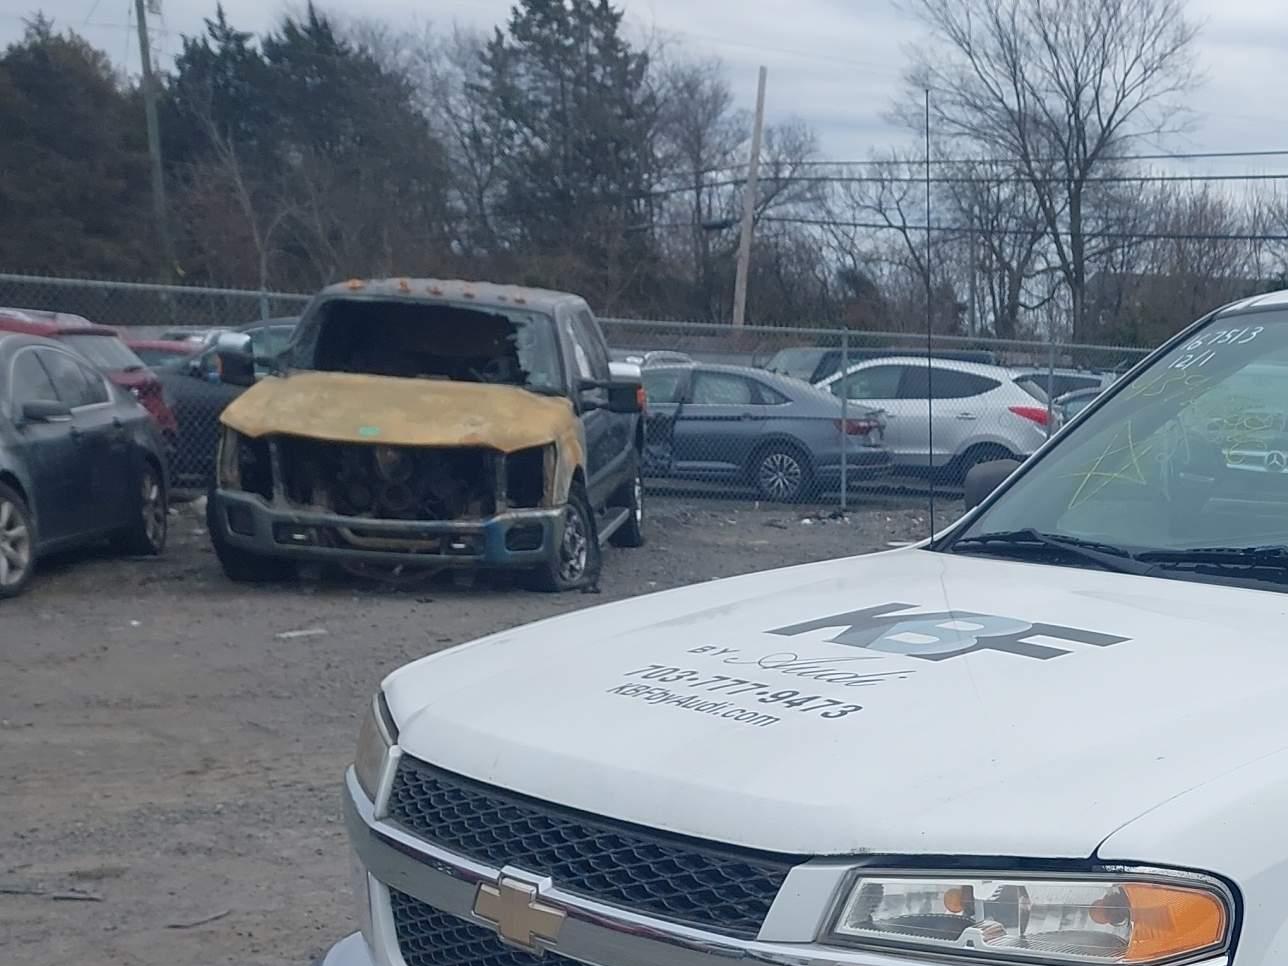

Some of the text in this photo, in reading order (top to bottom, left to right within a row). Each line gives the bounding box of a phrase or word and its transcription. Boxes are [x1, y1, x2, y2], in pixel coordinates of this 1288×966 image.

[687, 645, 740, 656] BY
[763, 602, 1133, 662] KBF
[607, 682, 781, 727] KBFbyAudi.com
